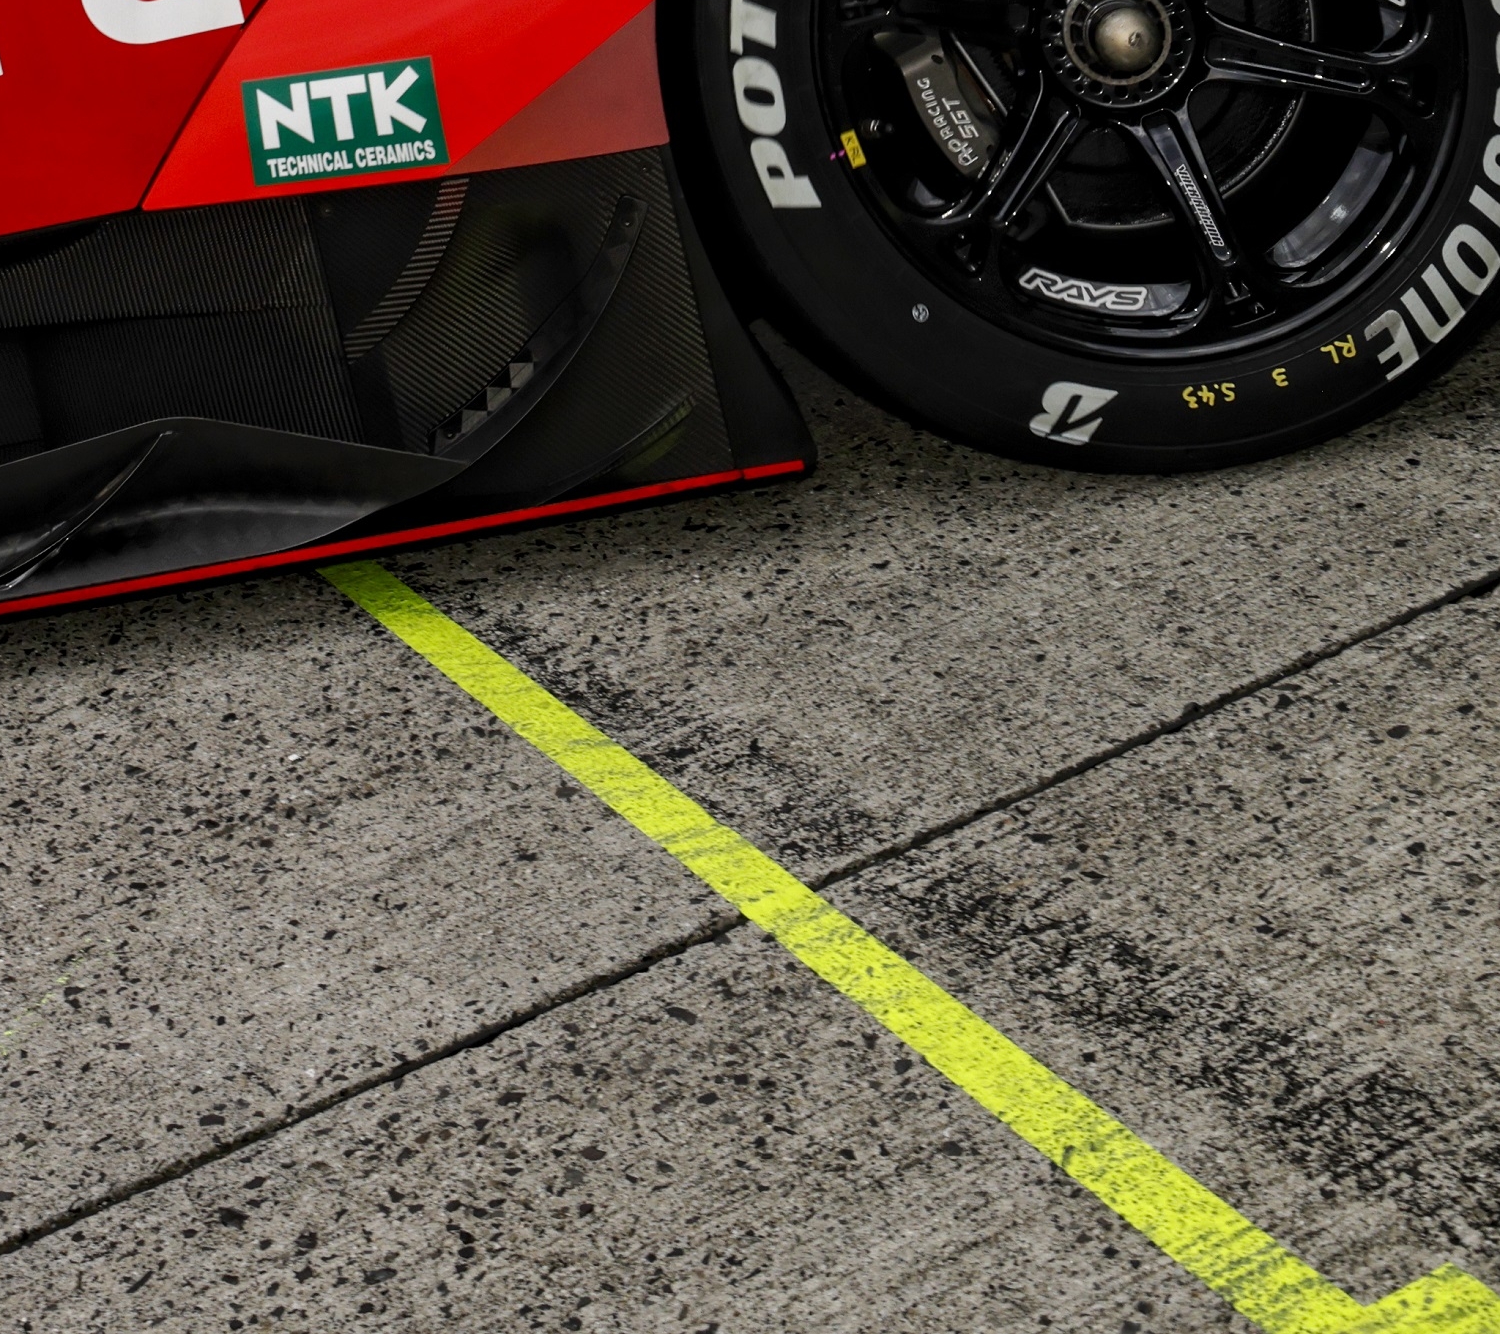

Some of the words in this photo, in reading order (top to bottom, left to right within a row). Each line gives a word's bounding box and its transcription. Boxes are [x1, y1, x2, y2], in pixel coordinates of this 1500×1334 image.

[256, 64, 428, 150] NTK
[917, 77, 954, 139] RACING
[267, 146, 353, 178] TECHNICAL
[356, 139, 437, 169] CERAMICS
[1019, 266, 1148, 312] RAYS
[1321, 334, 1357, 364] RL
[1272, 367, 1289, 387] 3
